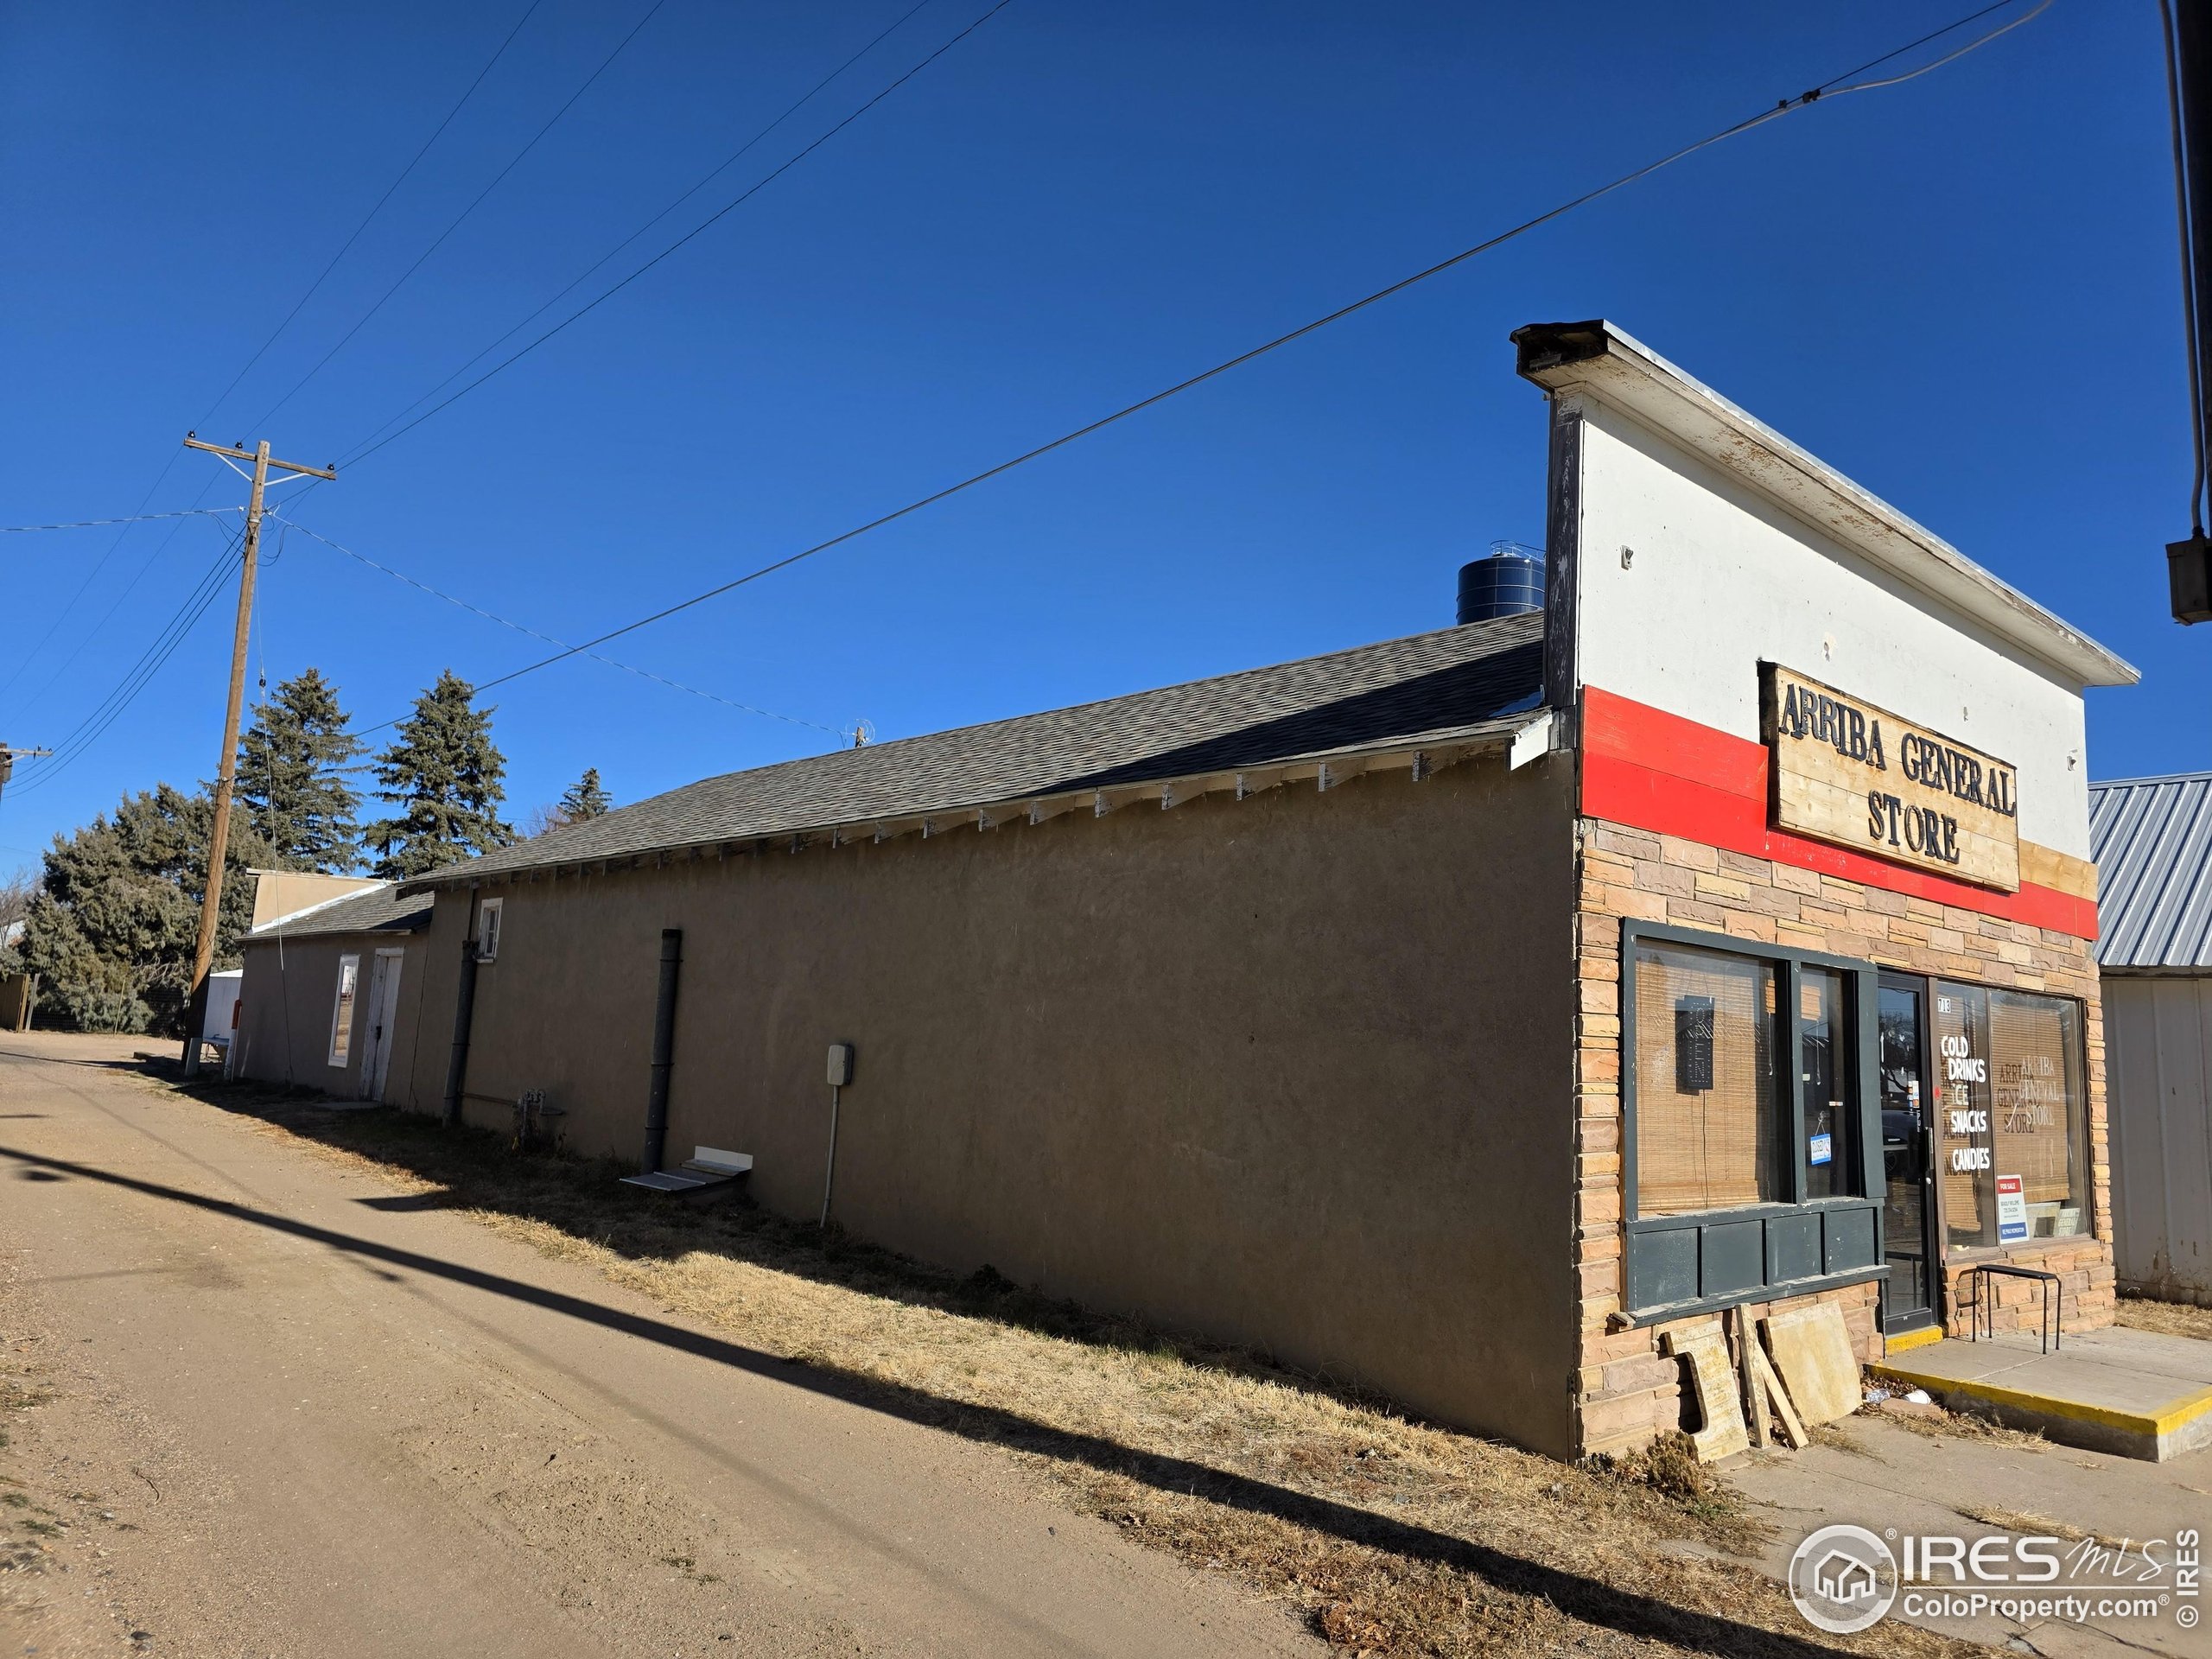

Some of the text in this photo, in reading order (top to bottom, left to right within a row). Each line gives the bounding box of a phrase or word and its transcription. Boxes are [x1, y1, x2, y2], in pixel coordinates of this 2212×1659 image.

[1778, 683, 2017, 818] ARRIBA GENERAL
[1868, 789, 1961, 864] STORE
[1941, 1035, 1969, 1058] COLD
[1948, 1058, 1986, 1084] DRINKS
[1950, 1110, 1987, 1134] SNACKS
[1952, 1147, 1991, 1171] CANDIES
